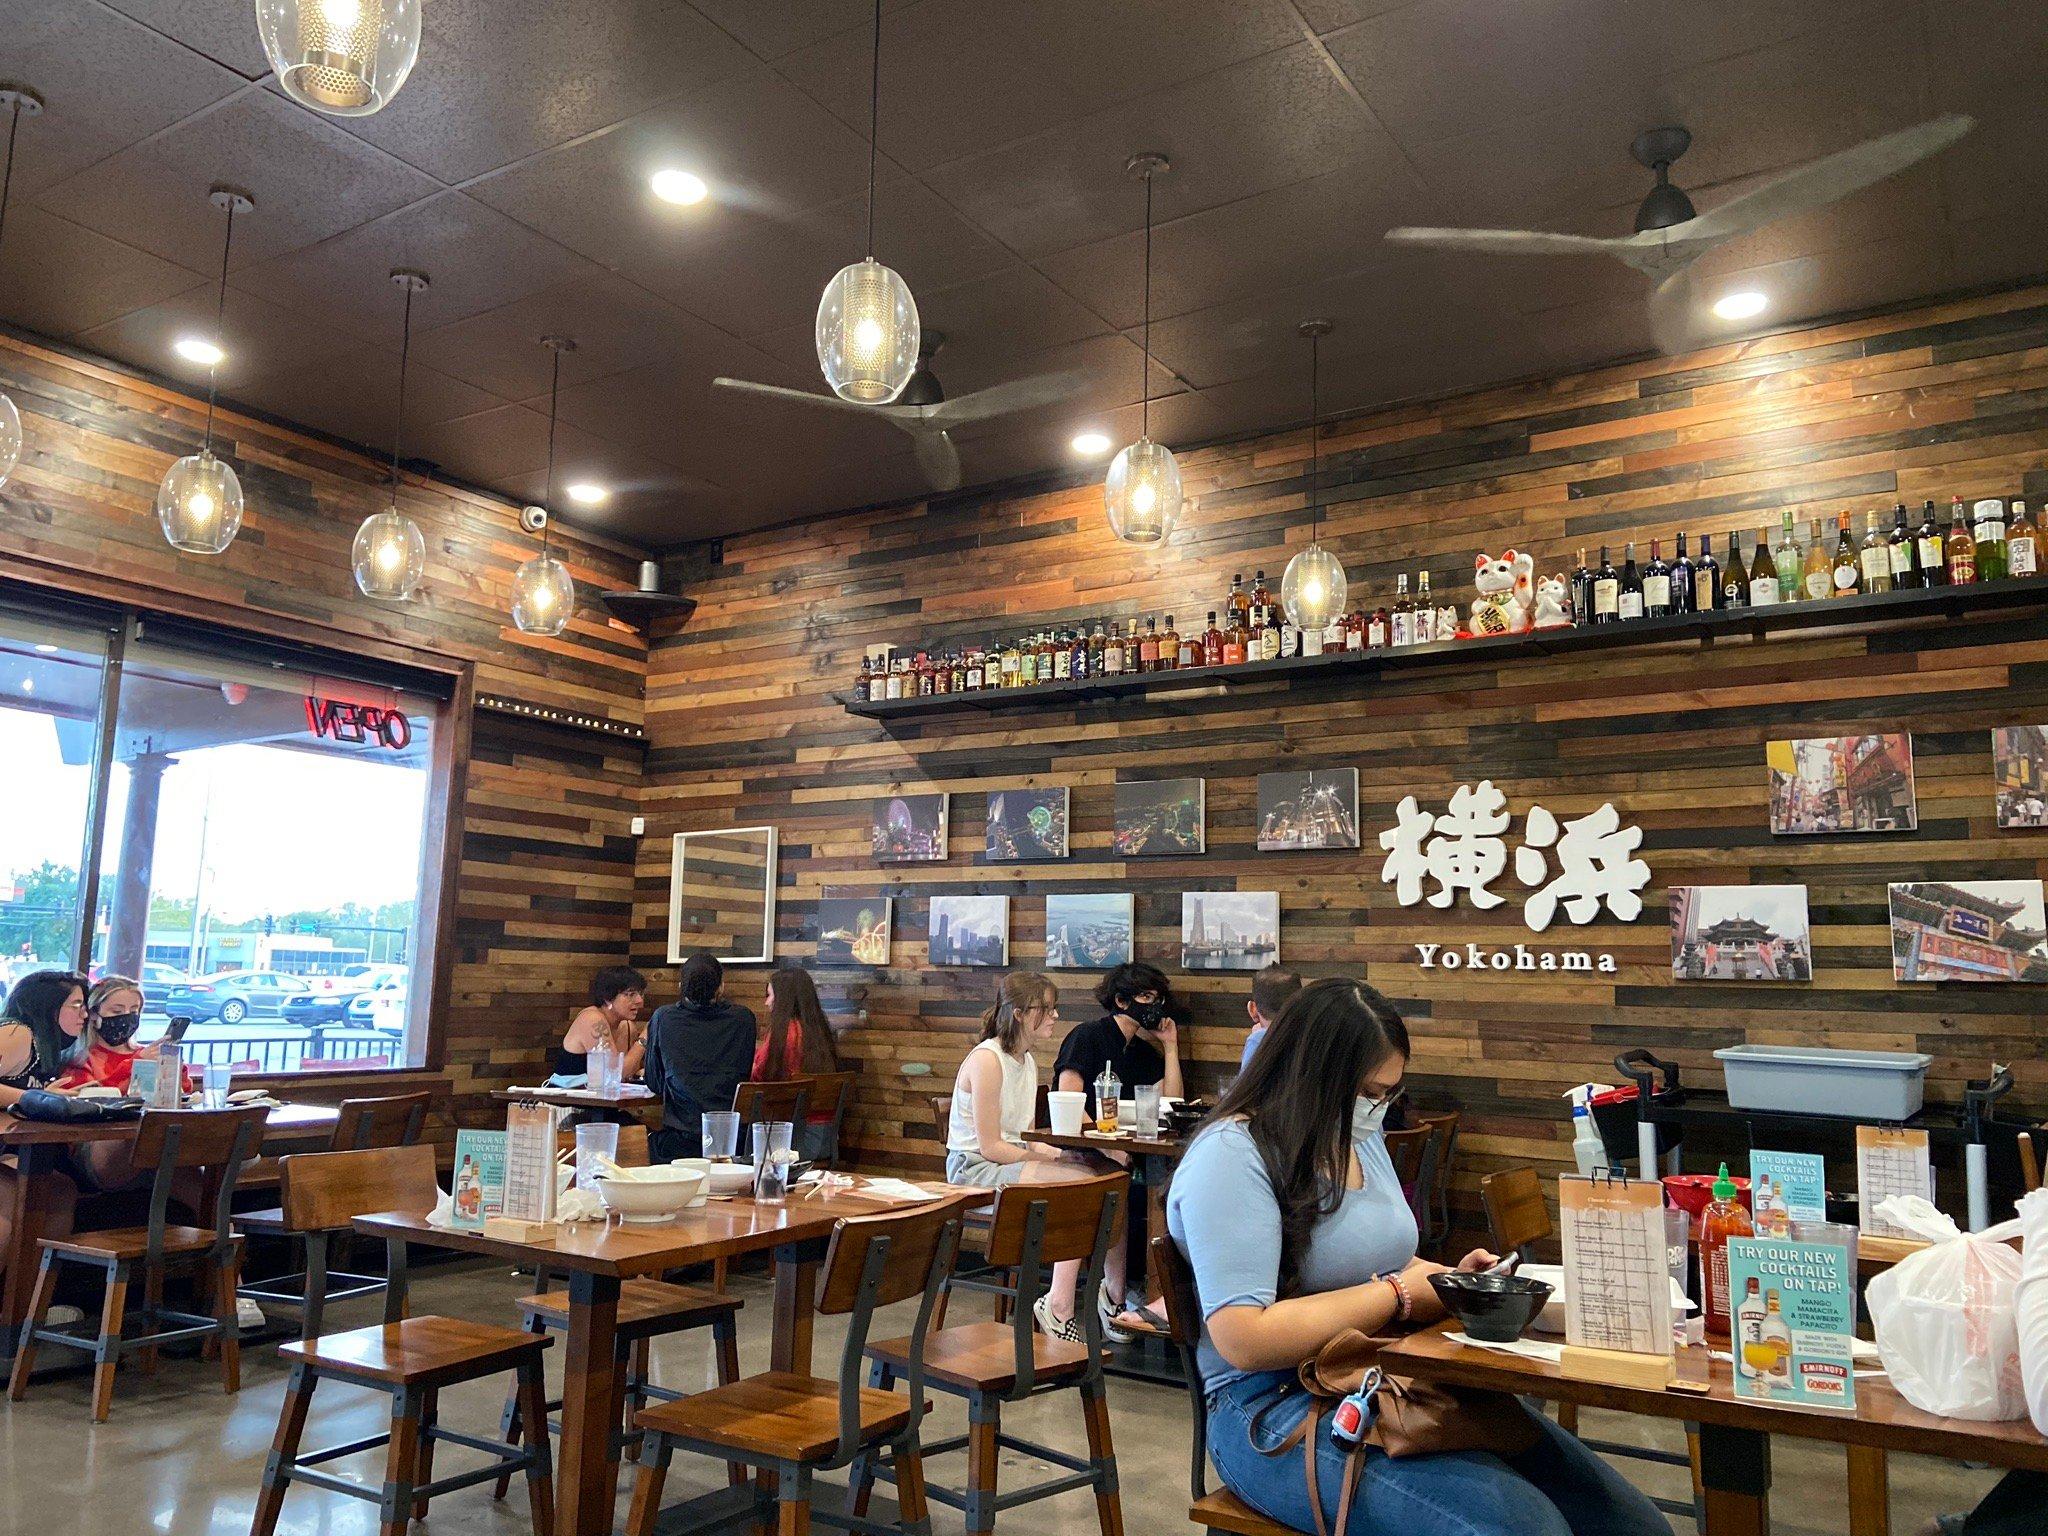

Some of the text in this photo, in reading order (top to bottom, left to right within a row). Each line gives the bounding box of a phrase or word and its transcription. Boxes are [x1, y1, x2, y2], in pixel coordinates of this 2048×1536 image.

[1379, 780, 1652, 932] 横浜
[1415, 944, 1617, 973] Yokohama
[1756, 1156, 1771, 1164] TRY
[1797, 1159, 1816, 1167] NEW
[1769, 1166, 1816, 1175] COCKTAILS
[1784, 1175, 1796, 1183] ON
[1737, 1246, 1836, 1265] TRY OUR NEW
[1760, 1262, 1837, 1279] COCKTAILS
[1784, 1278, 1842, 1294] ON TAP!
[1802, 1299, 1831, 1307] MANGO
[1798, 1306, 1839, 1315] MAMACITA
[1799, 1313, 1844, 1323] STRAWBERRY
[1801, 1321, 1837, 1329] PAPACITO
[1803, 1364, 1843, 1375] SMIRNOFF
